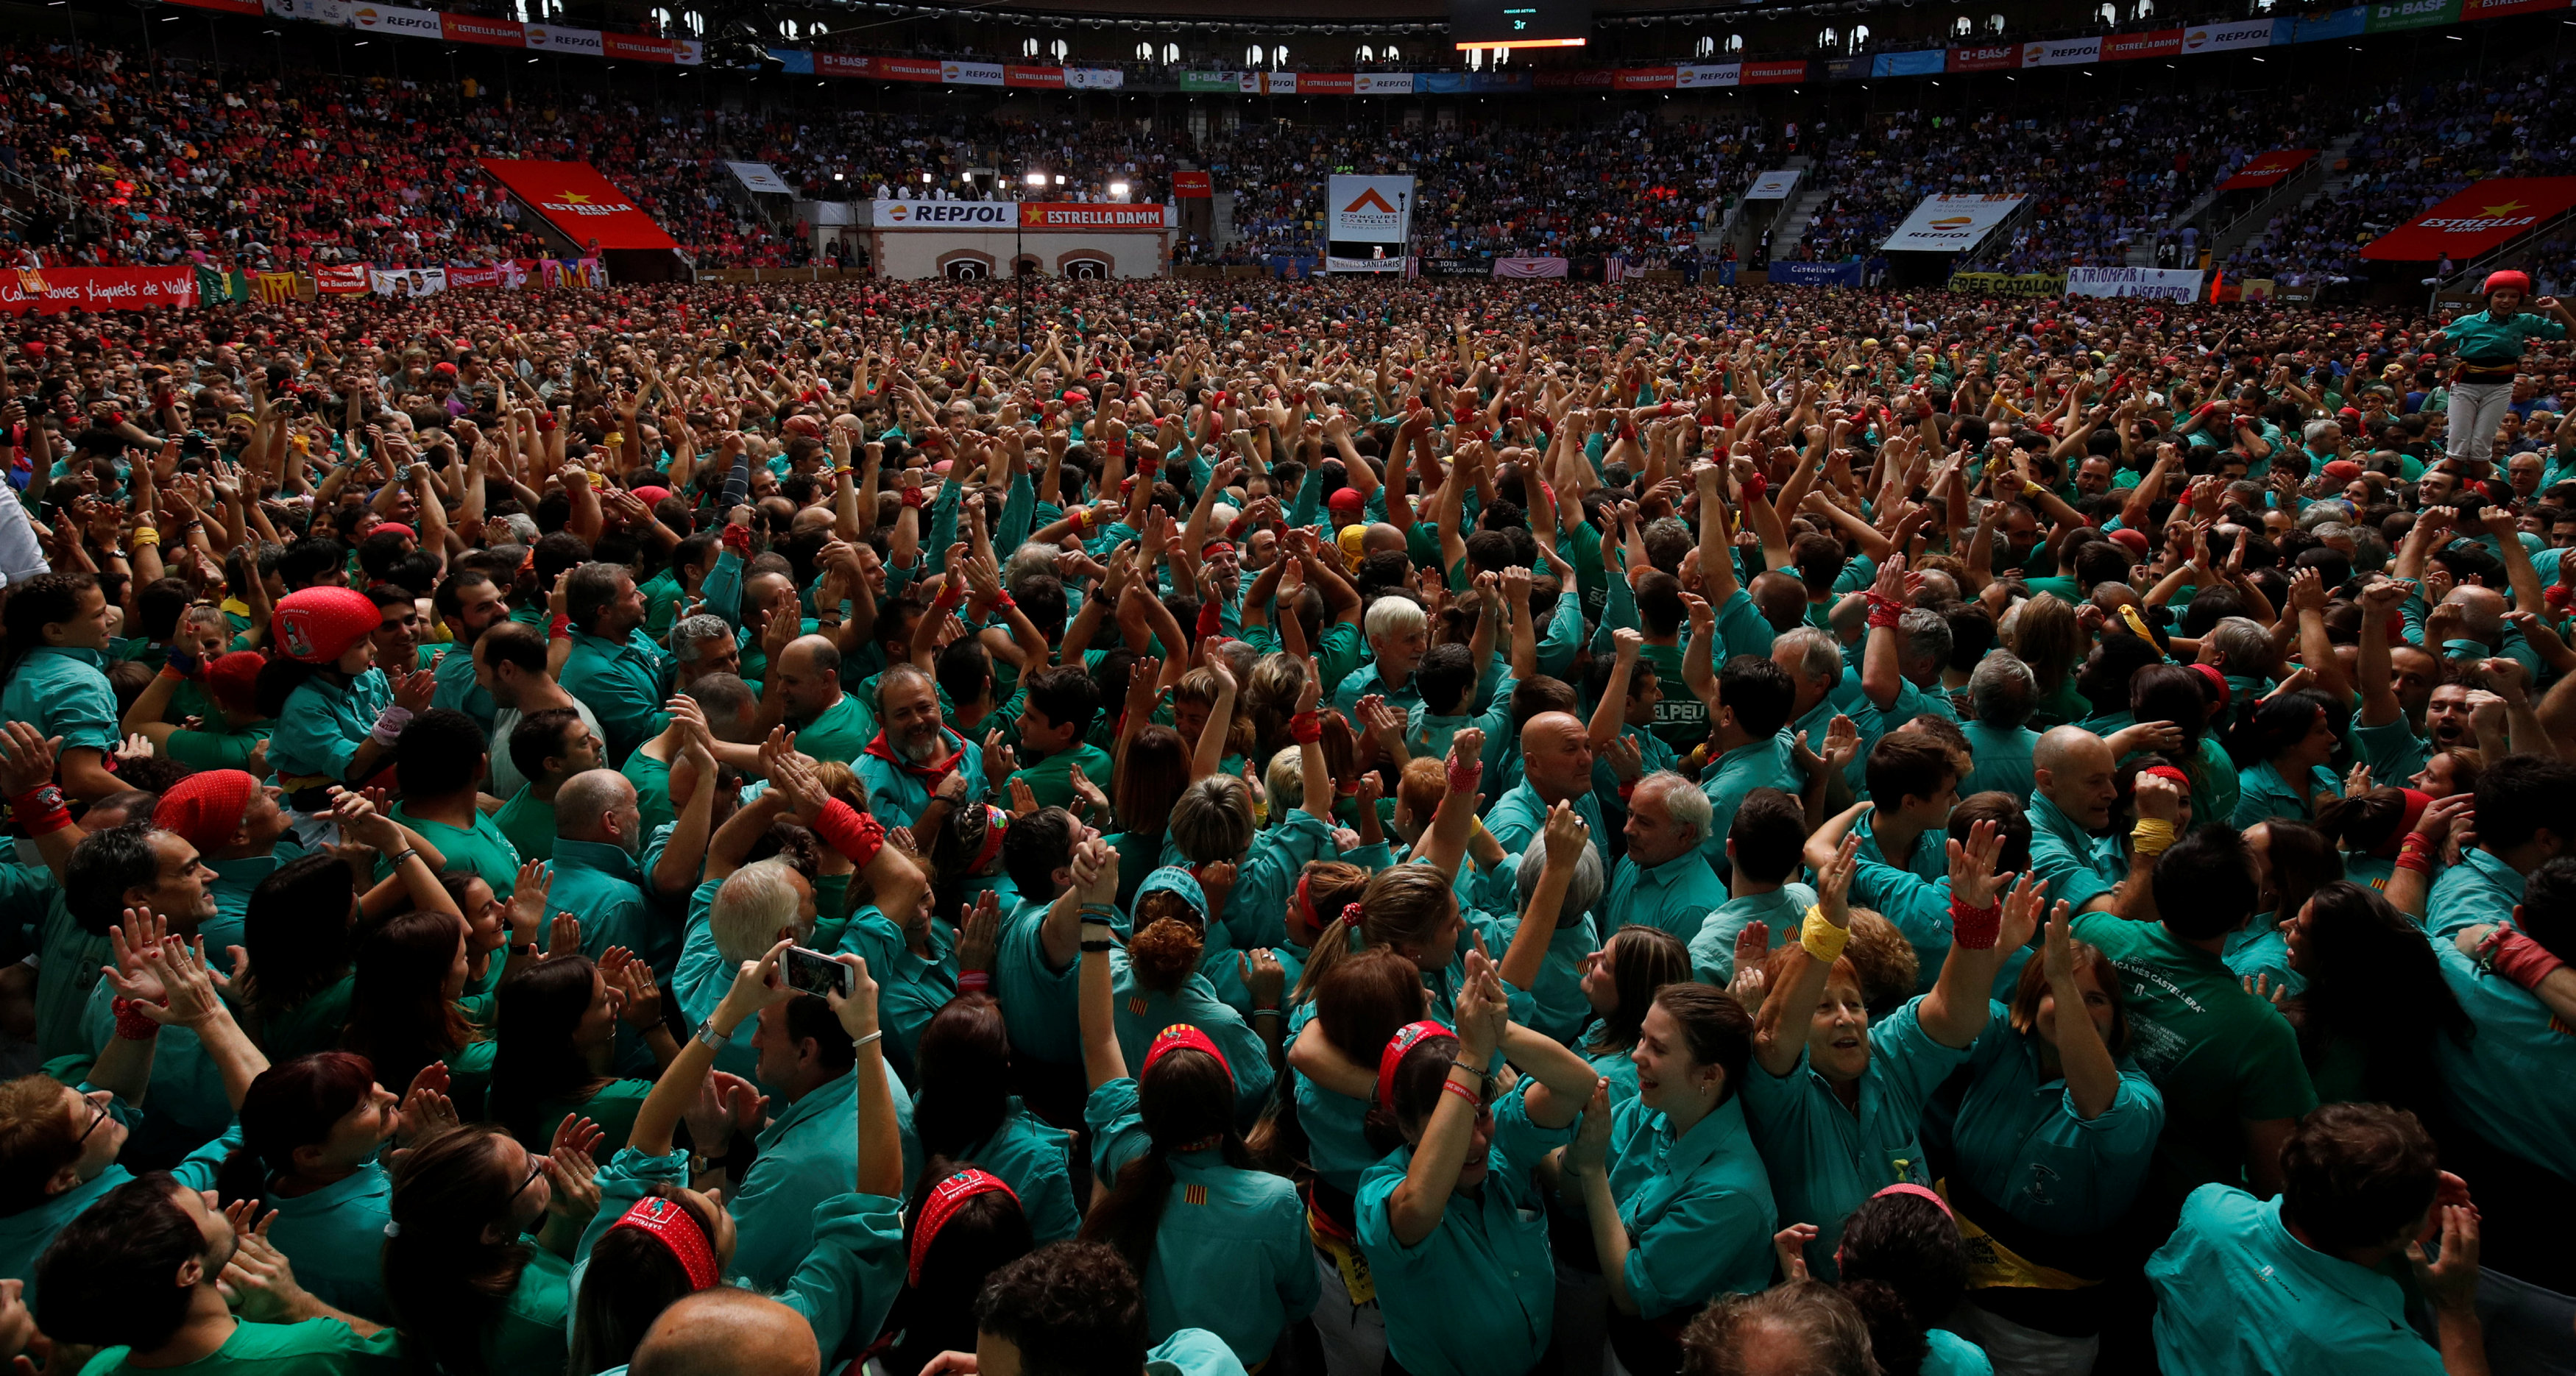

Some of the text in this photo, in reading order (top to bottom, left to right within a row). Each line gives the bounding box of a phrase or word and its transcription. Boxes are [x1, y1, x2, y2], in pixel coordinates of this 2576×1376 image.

[2402, 0, 2446, 15] BASF
[387, 15, 439, 29] REPSOL
[1514, 20, 1526, 29] 3r
[458, 24, 521, 38] ESTRELLA DAMM
[2215, 29, 2269, 42] REPSOL
[555, 35, 601, 47] REPSOL
[2115, 38, 2179, 51] ESTRELA DAMM
[617, 42, 673, 54] ESTRELLA DAMM
[1978, 47, 2011, 60] BASF
[2051, 46, 2098, 57] REPSOL
[839, 57, 868, 67] BASF
[891, 66, 920, 74] ESTRELLA
[966, 70, 1002, 79] REPSOL
[1700, 71, 1738, 80] REPSOL
[1078, 74, 1084, 83] 3
[1495, 74, 1522, 82] BAF
[541, 202, 634, 212] ESTRELLA
[916, 206, 1005, 221] REPSOL
[1047, 210, 1160, 224] ESTRELLA DAMM
[2417, 216, 2537, 227] ESTRELLA
[1332, 260, 1400, 269] SERVEIS SANITARIS
[1791, 266, 1836, 274] Castellers
[1449, 267, 1466, 275] PLAÇA
[2070, 269, 2078, 283] A
[1, 282, 40, 302] Col
[44, 282, 80, 299] Joves
[142, 280, 158, 295] de
[1950, 277, 2066, 293] FREE CATALONI
[2116, 285, 2125, 298] A
[1669, 704, 1705, 720] PEU
[2128, 955, 2175, 981] HEREUS DE
